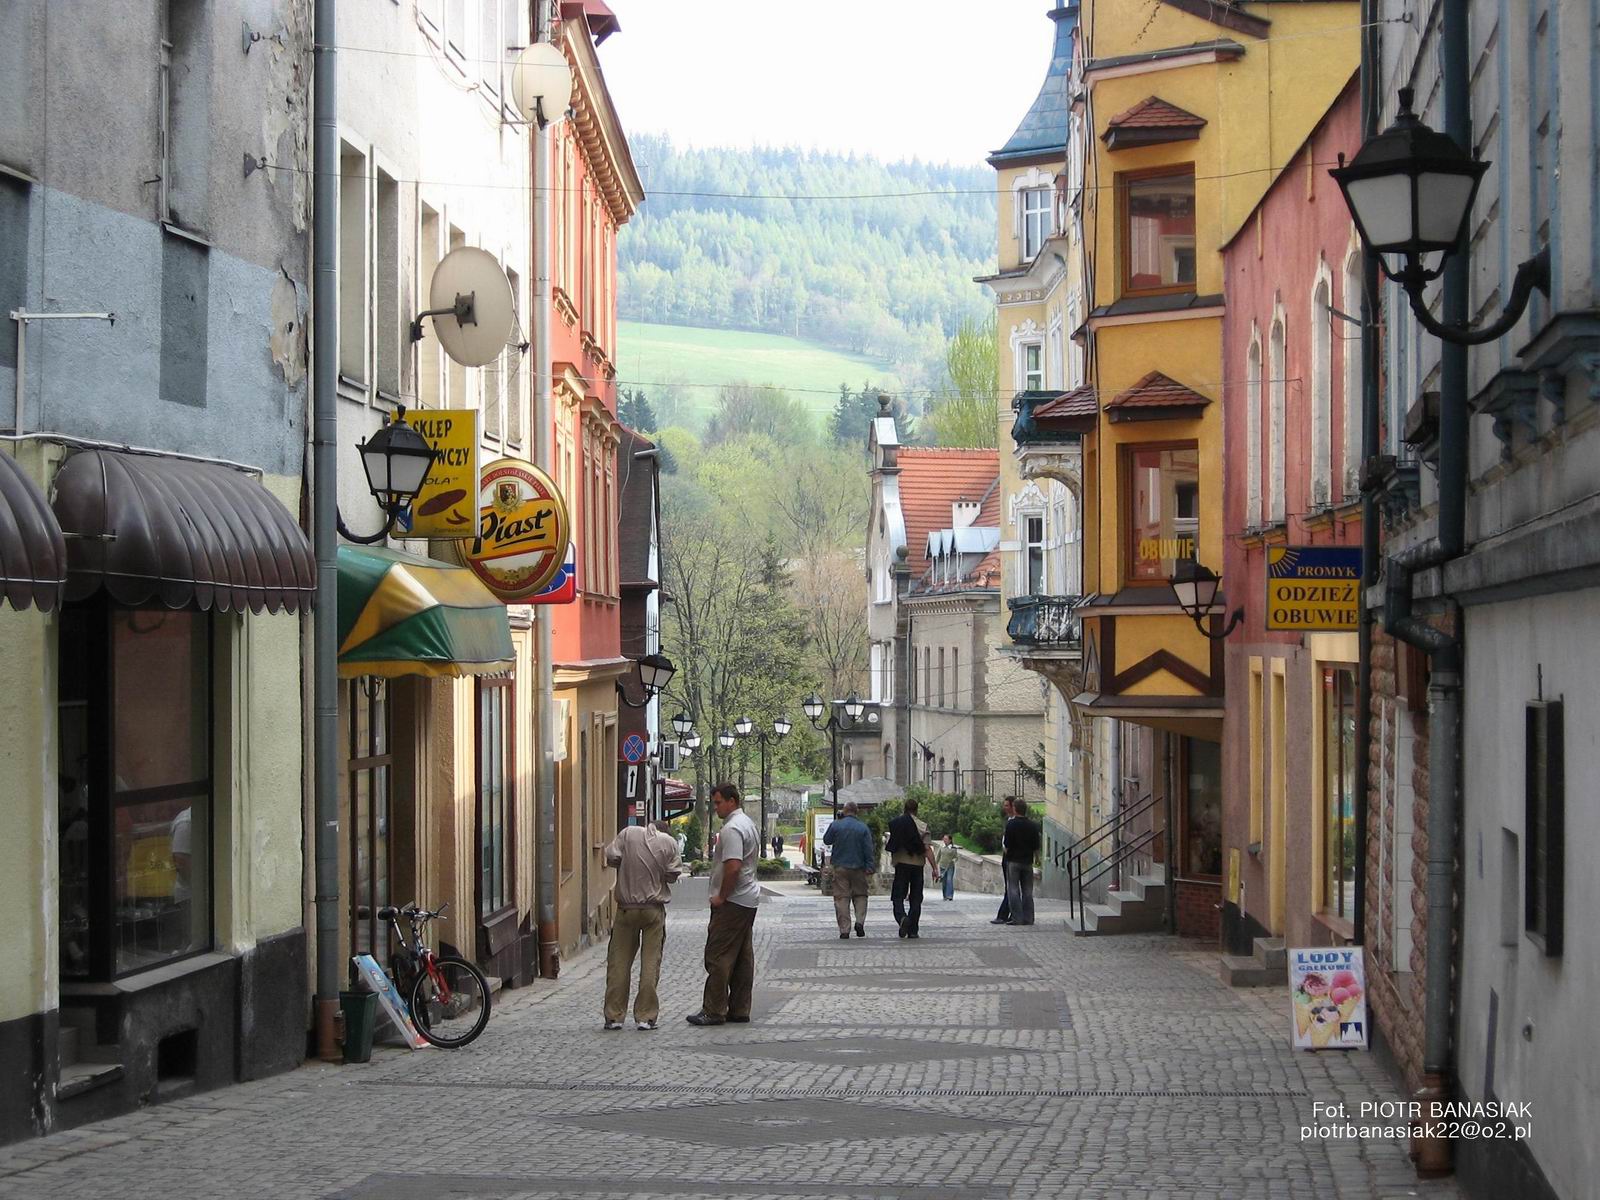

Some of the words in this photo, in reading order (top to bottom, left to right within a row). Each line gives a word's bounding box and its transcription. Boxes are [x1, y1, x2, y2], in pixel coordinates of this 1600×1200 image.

[413, 419, 452, 438] SKLEP
[471, 508, 552, 555] Piast
[1297, 566, 1356, 577] PROMYK
[1276, 584, 1355, 602] ODZIEŻ
[1273, 608, 1358, 625] OBUWIE
[1297, 951, 1353, 964] LODY
